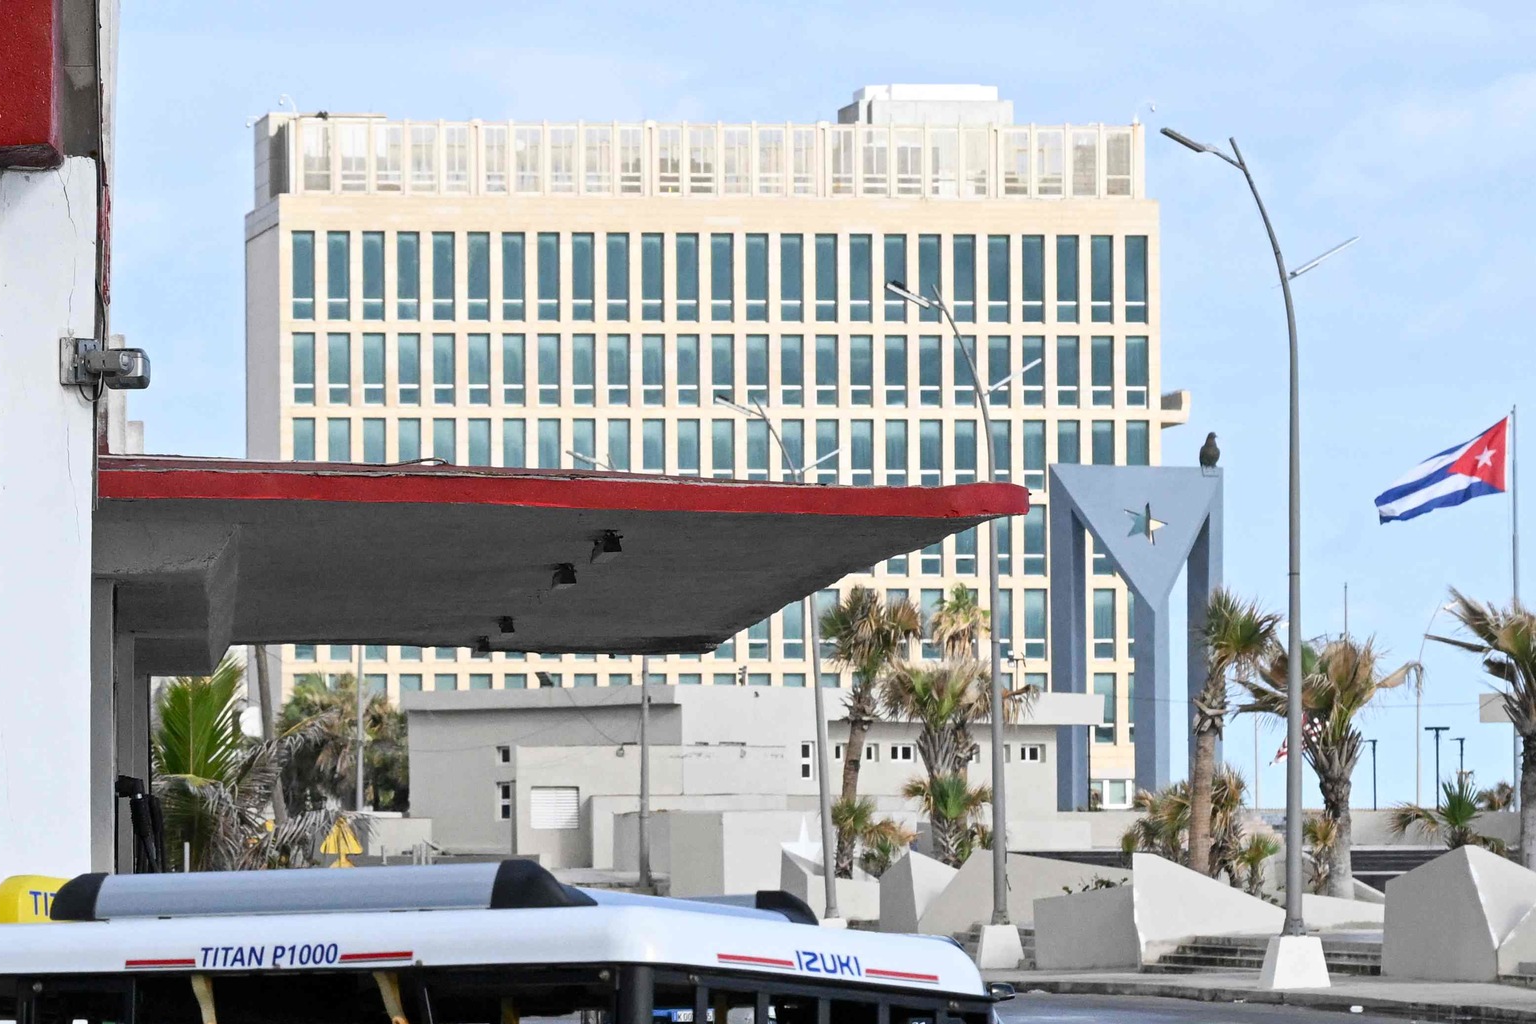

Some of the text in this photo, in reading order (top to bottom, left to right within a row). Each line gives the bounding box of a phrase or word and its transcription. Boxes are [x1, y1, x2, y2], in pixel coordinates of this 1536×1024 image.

[201, 943, 338, 967] TITAN P1000
[796, 950, 861, 977] IZUKI
